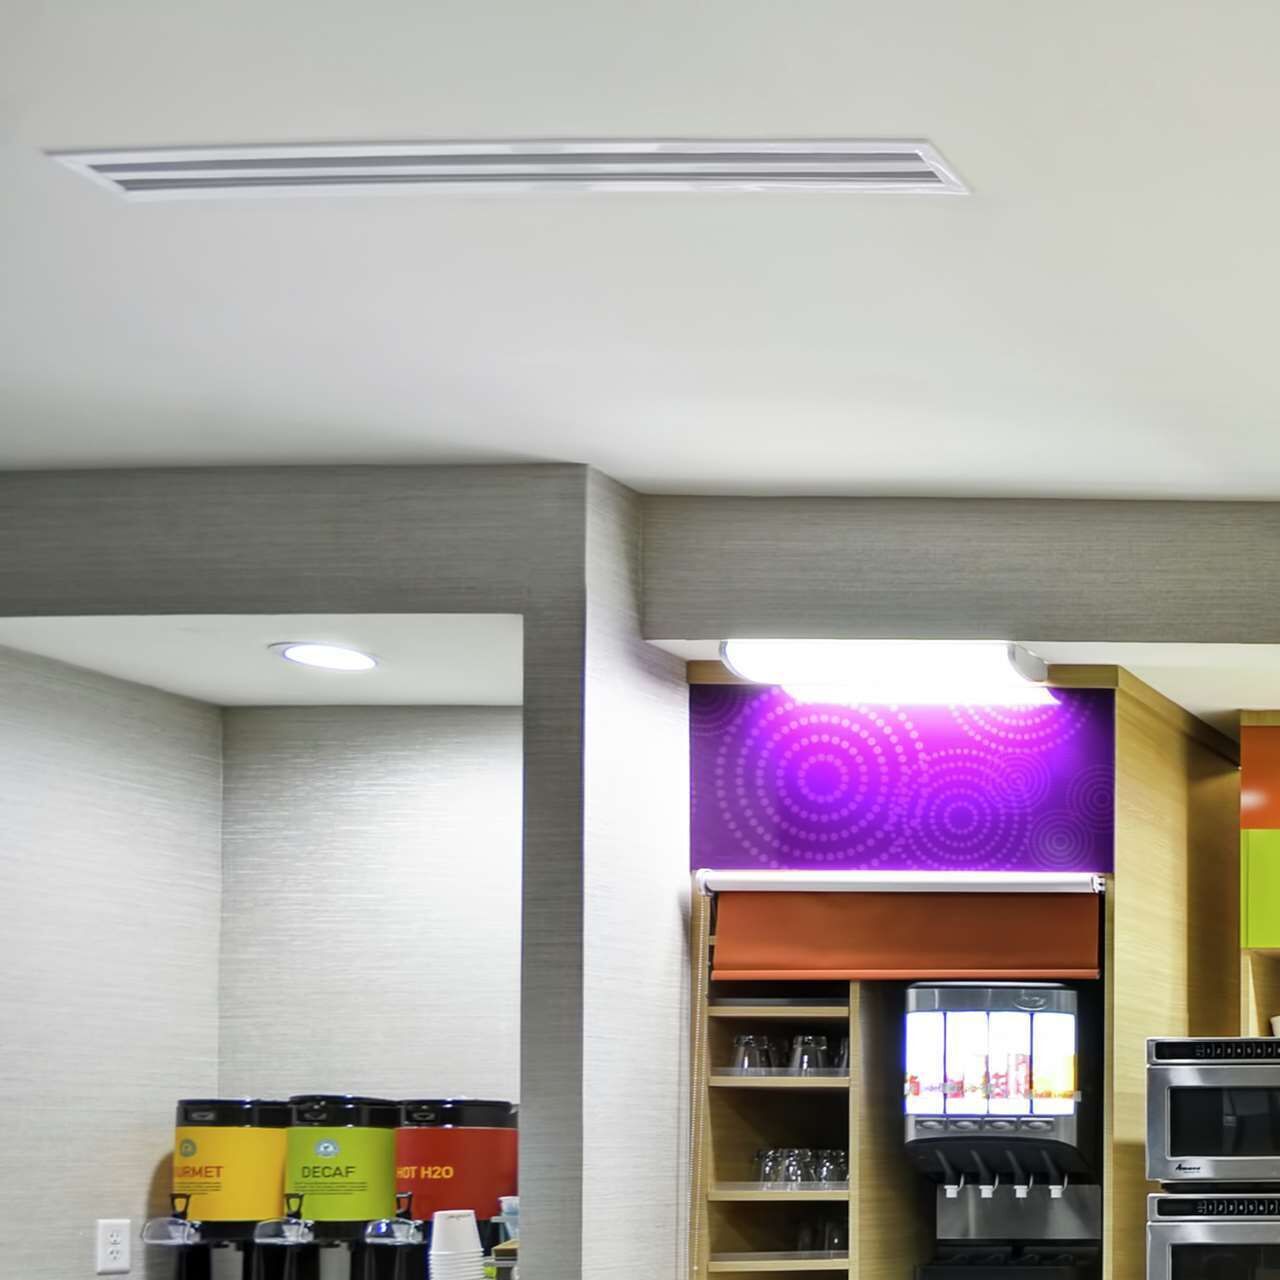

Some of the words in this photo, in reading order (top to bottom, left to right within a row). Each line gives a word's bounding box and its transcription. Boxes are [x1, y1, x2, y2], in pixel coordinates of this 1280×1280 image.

[301, 1165, 356, 1178] DECAF
[396, 1166, 418, 1179] HOT
[420, 1166, 455, 1179] H2O
